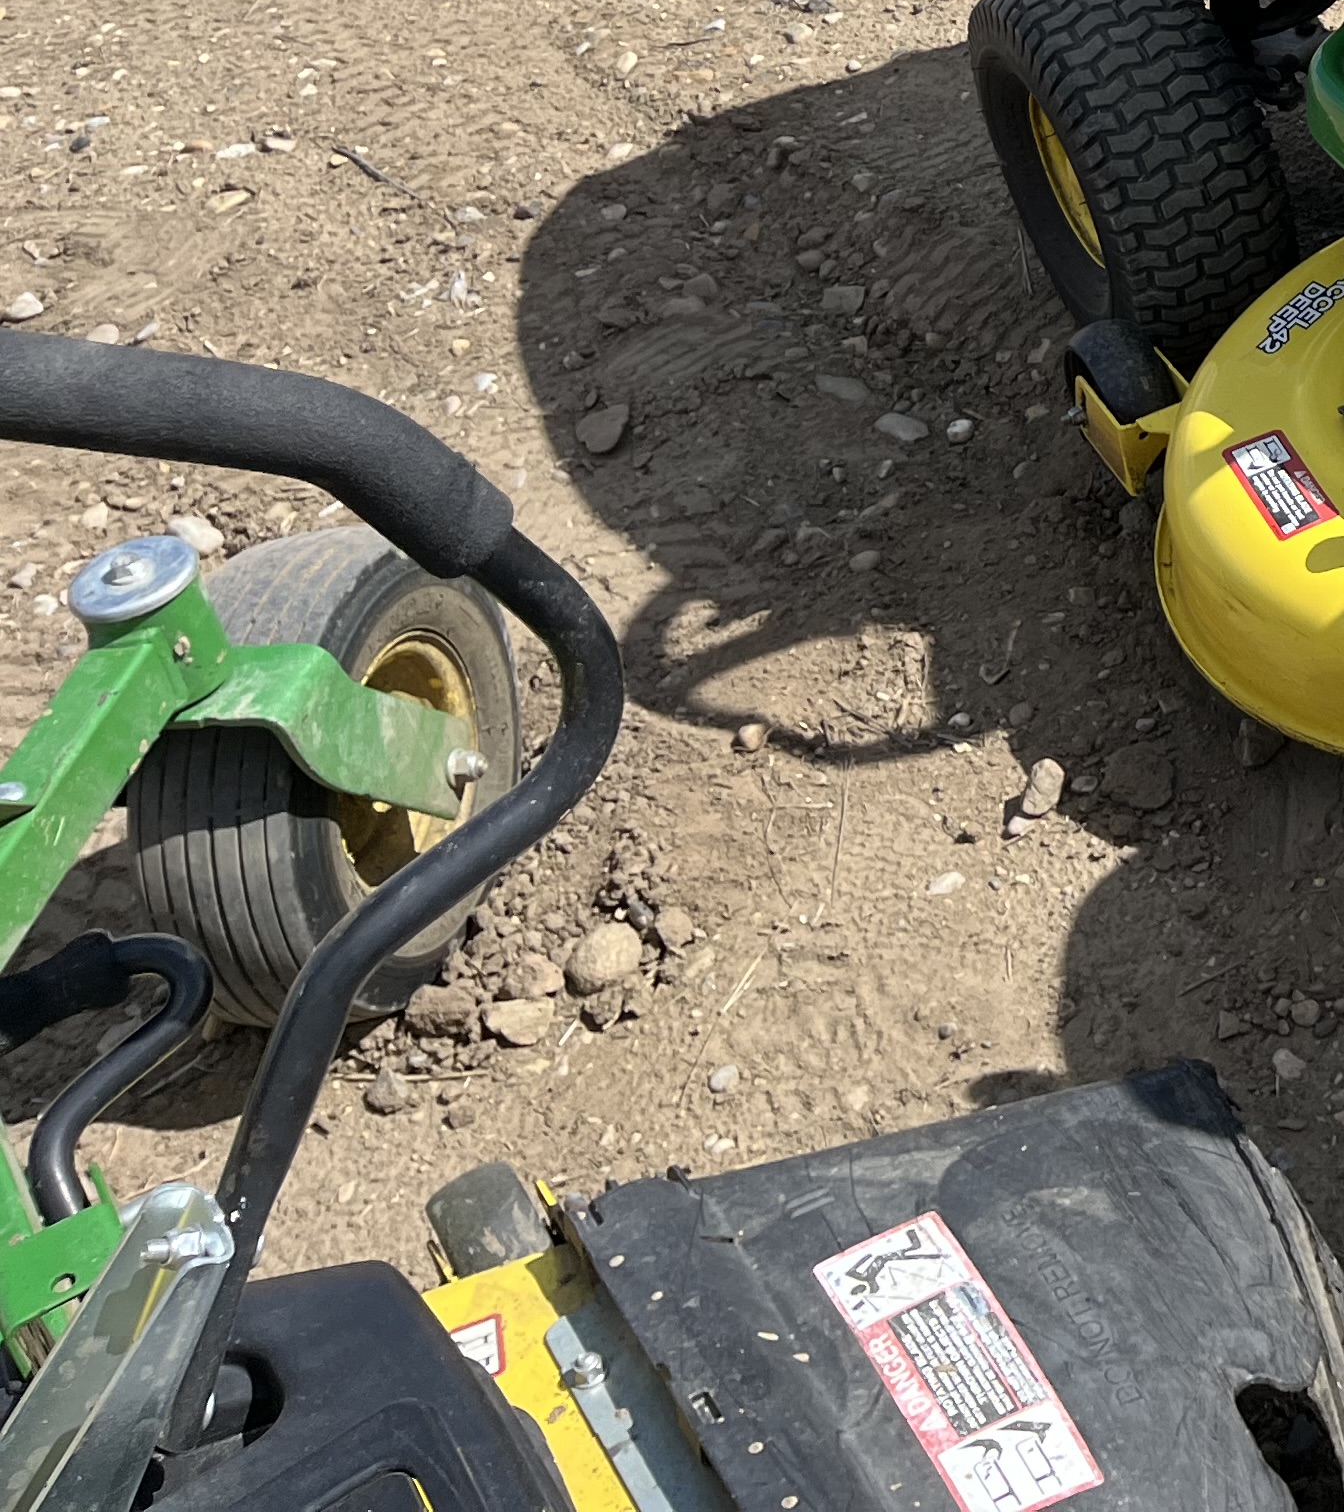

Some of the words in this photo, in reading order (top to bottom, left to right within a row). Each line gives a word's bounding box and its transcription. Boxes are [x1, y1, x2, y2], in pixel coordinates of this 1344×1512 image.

[1266, 280, 1327, 336] DEEP
[1258, 325, 1292, 356] 42
[1000, 1202, 1080, 1303] REMOVE
[1065, 1300, 1119, 1362] NOT
[868, 1332, 931, 1417] DANGER
[1103, 1361, 1145, 1409] DO
